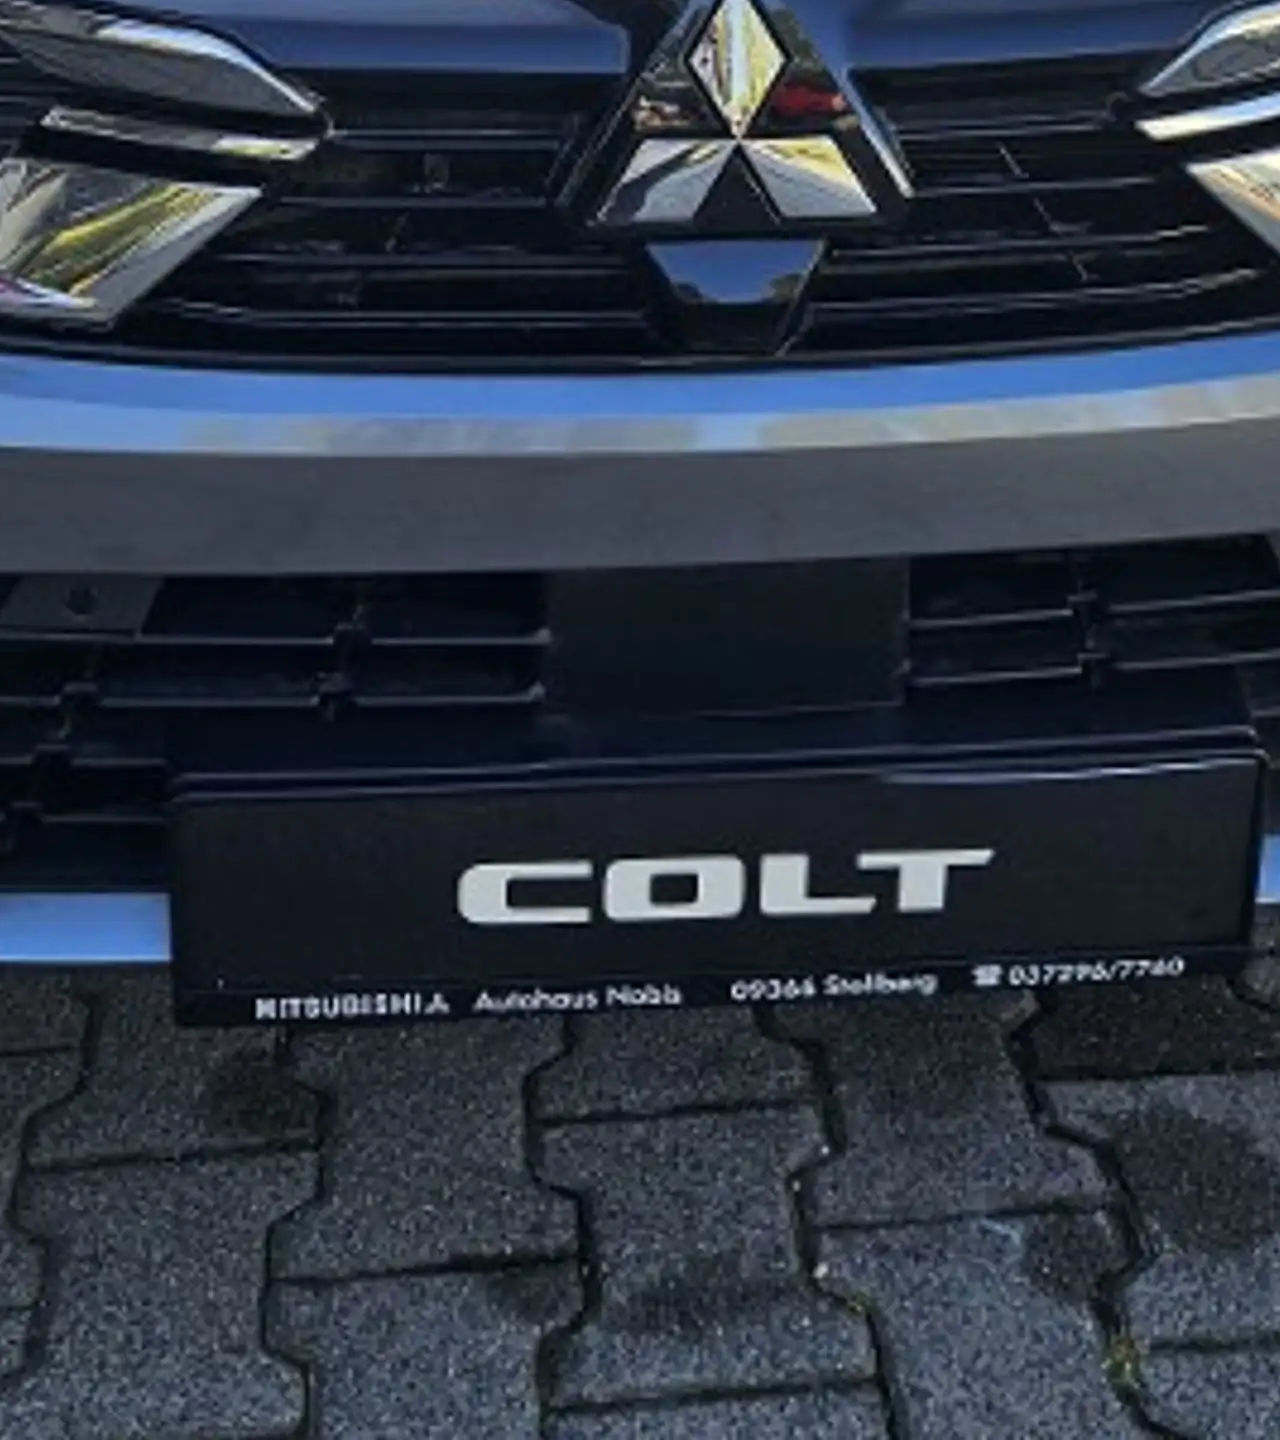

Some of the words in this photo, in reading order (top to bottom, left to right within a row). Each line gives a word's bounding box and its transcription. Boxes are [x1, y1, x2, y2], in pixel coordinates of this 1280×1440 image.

[458, 848, 995, 924] COLT
[255, 991, 420, 1020] MITSUBISHI
[472, 987, 599, 1013] Autohaus
